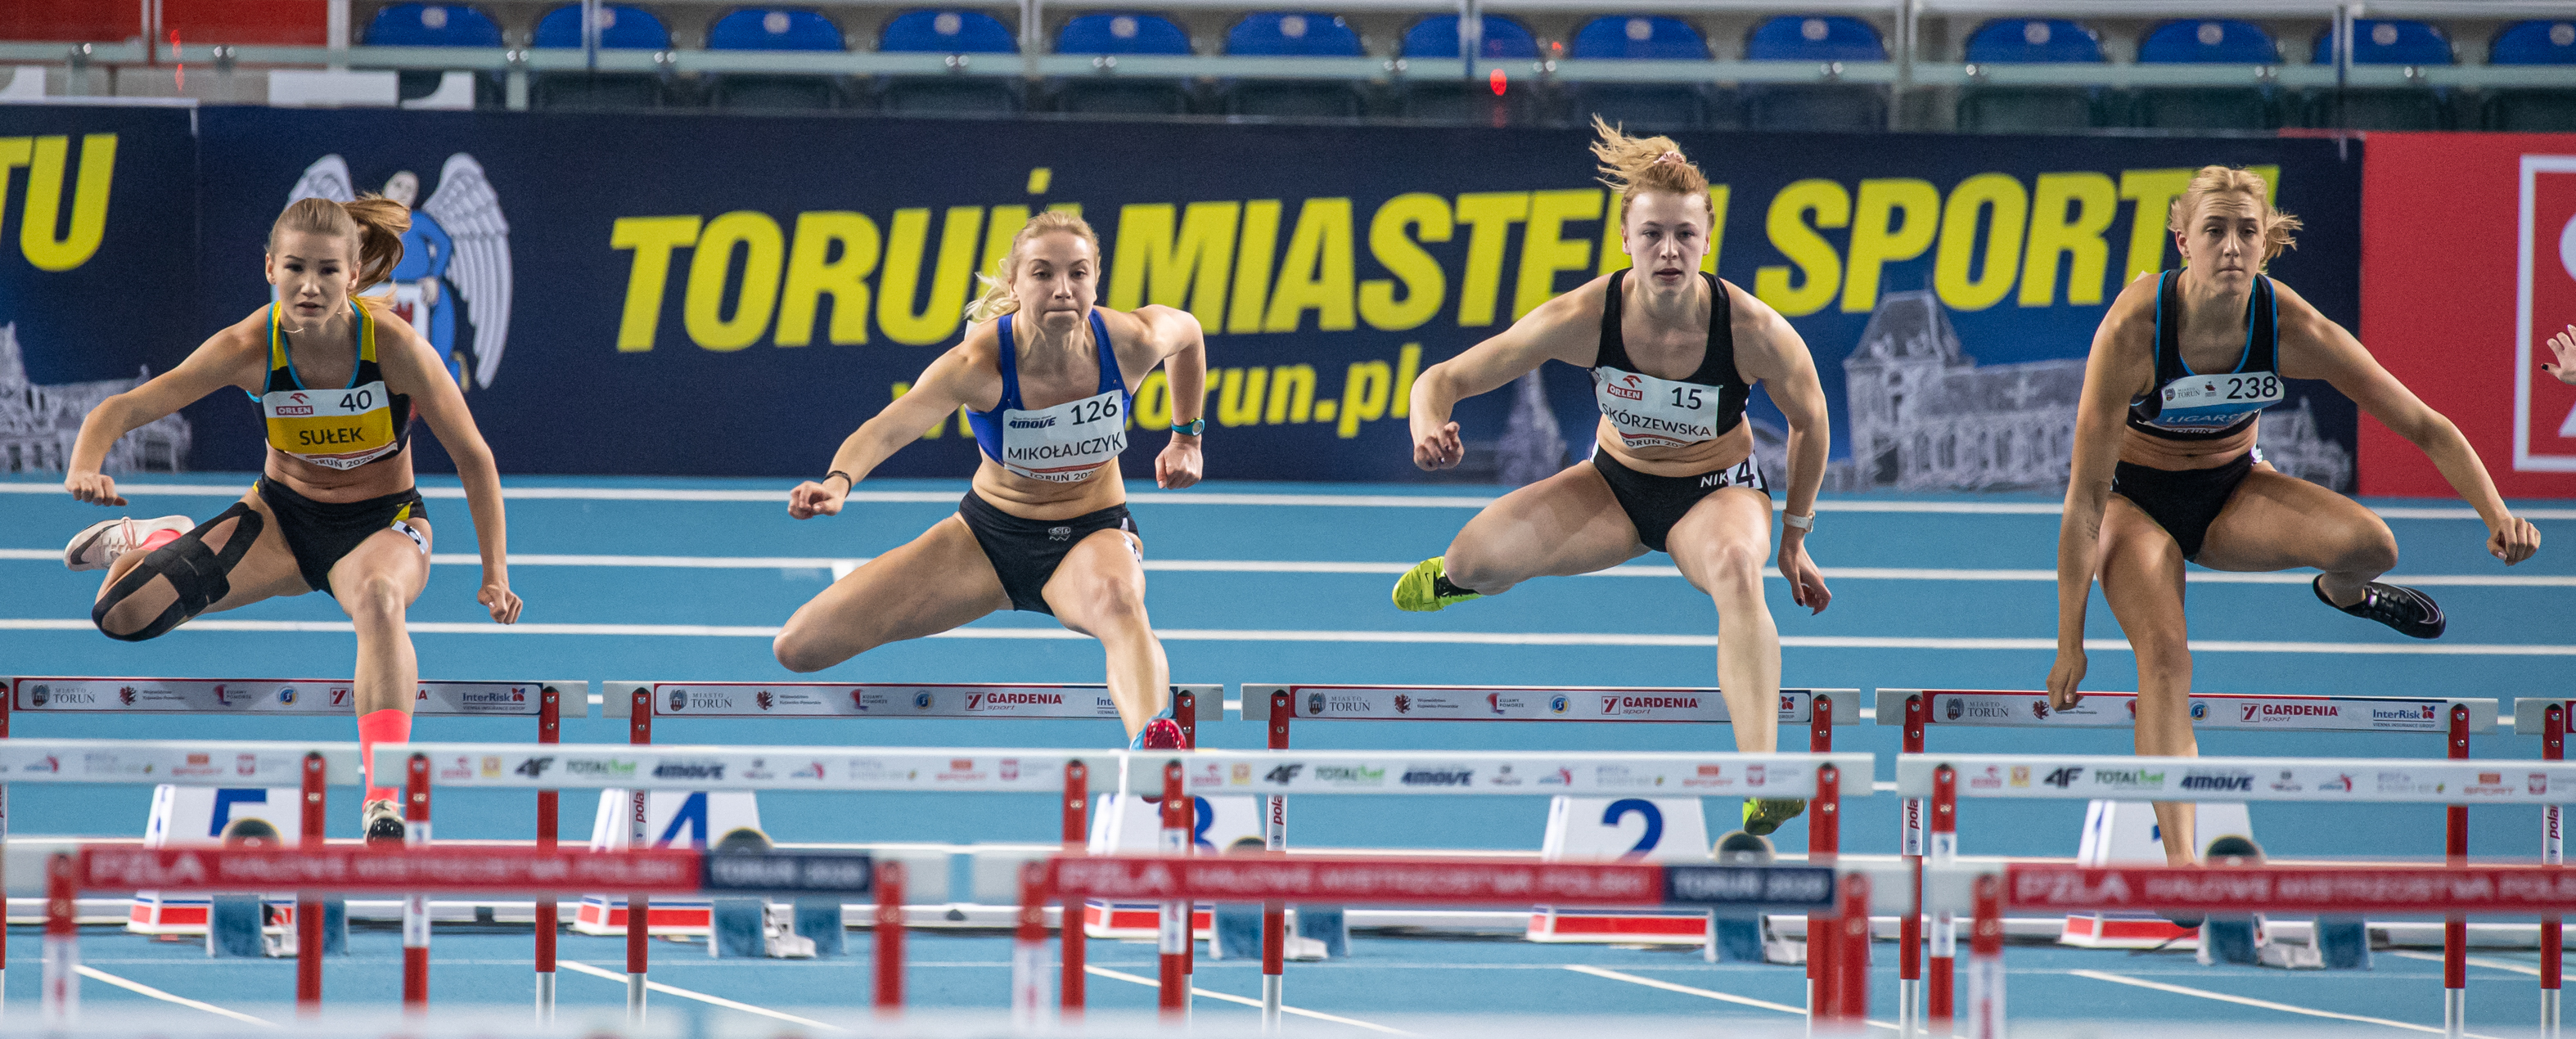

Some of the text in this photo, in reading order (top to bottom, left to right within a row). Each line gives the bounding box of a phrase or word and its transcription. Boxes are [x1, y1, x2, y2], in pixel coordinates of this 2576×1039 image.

[1754, 165, 2280, 317] SPORT
[1609, 386, 1641, 399] ORLEN
[2227, 376, 2278, 400] 238
[339, 389, 372, 412] 40
[1671, 386, 1703, 411] 15
[278, 407, 312, 415] ORLEN
[1070, 395, 1118, 425] 126
[1008, 416, 1057, 429] 4MOVE
[1601, 403, 1712, 437] SKÓRZEWSKA
[299, 426, 365, 445] SUŁEK
[1007, 431, 1124, 461] MIKOŁAJCZYK
[311, 458, 342, 468] ORUŃ
[346, 455, 374, 468] 2020
[1029, 470, 1095, 482] TORUŃ 202
[1700, 472, 1728, 488] NIK
[1735, 457, 1755, 488] 4
[53, 690, 95, 704] TORUŃ
[462, 692, 511, 702] InterRisk
[691, 695, 732, 708] TORUŃ
[987, 692, 1063, 704] GARDENIA
[1623, 696, 1698, 708] GARDENIA
[1330, 699, 1371, 712] TORUŃ
[1968, 704, 2009, 717] TORUŃ
[2263, 704, 2339, 717] GARDENIA
[2373, 708, 2421, 719] InterRisk
[2044, 767, 2085, 789] 4F
[633, 789, 646, 824] pola
[1272, 795, 1285, 826] pola
[1908, 797, 1921, 830] pola
[1601, 798, 1664, 865] 2
